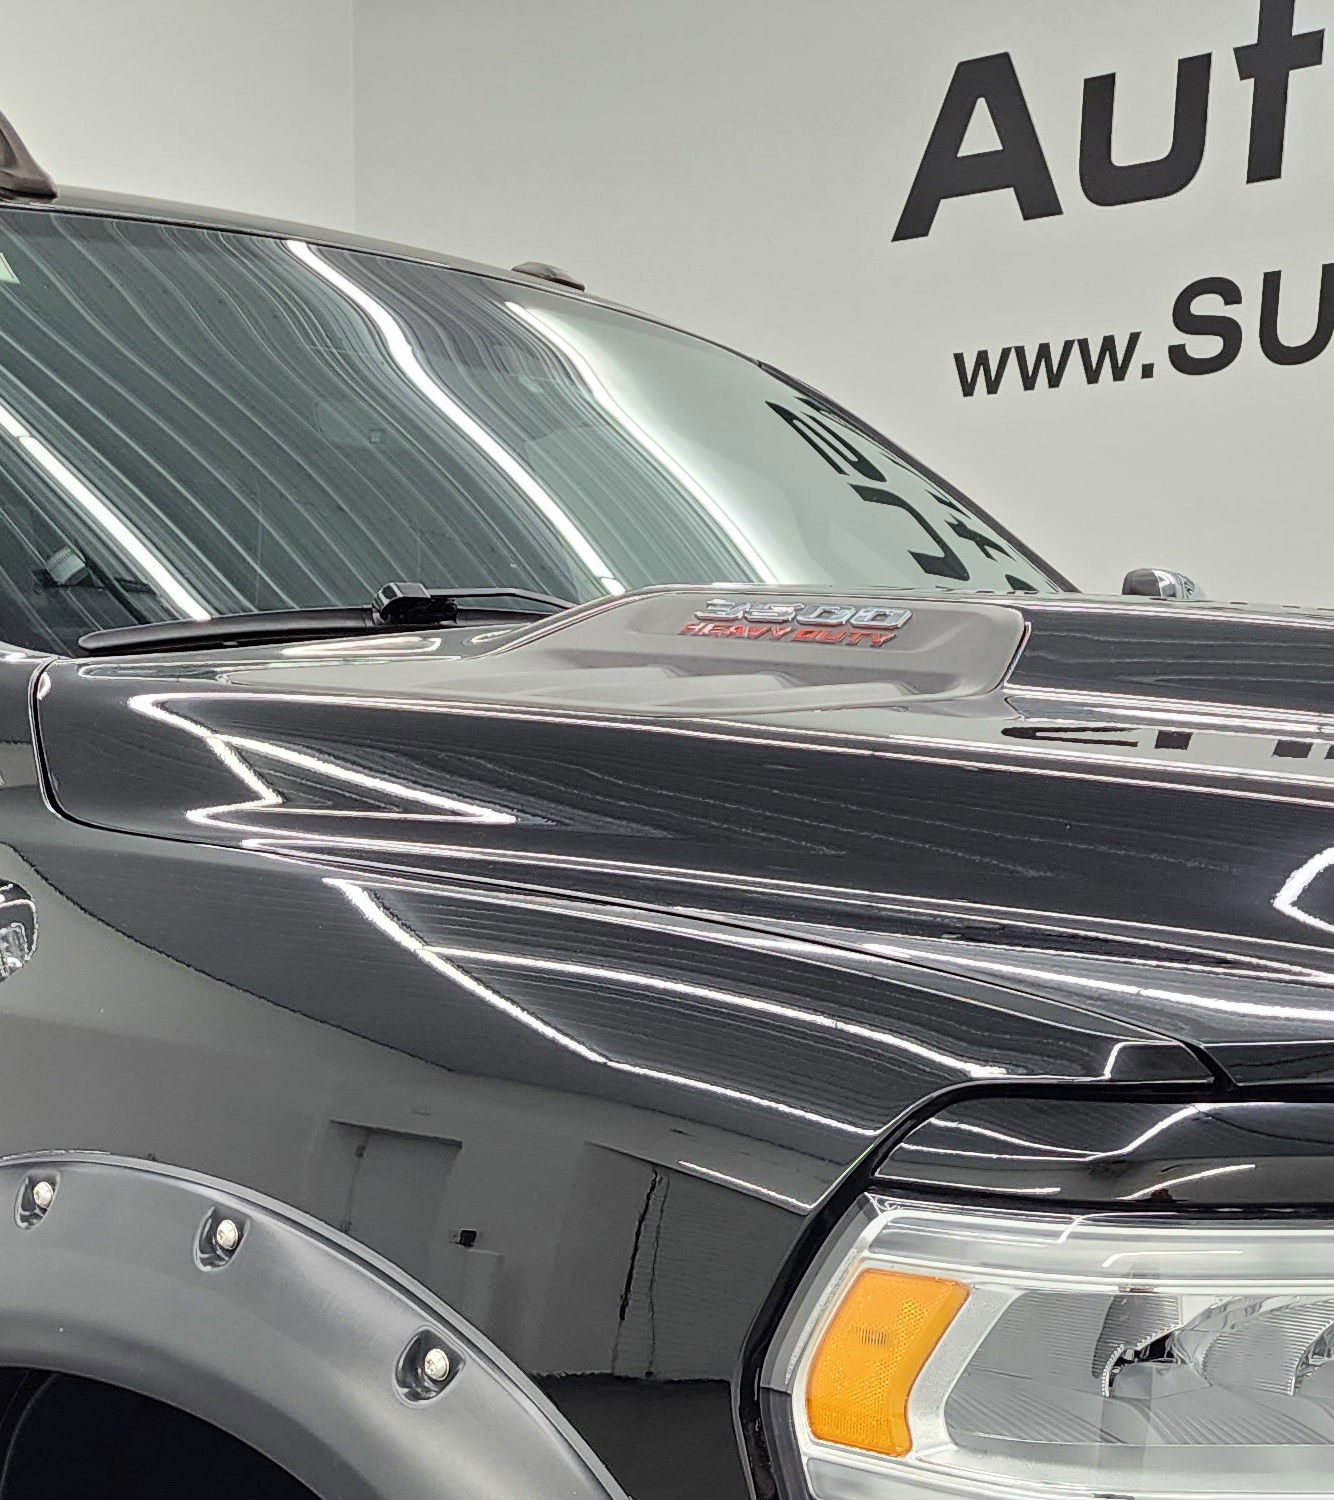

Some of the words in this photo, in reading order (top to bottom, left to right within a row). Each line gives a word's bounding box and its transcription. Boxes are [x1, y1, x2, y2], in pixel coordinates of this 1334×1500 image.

[693, 598, 914, 630] 3500
[677, 622, 794, 641] HEAVY
[791, 628, 898, 648] DUTY
